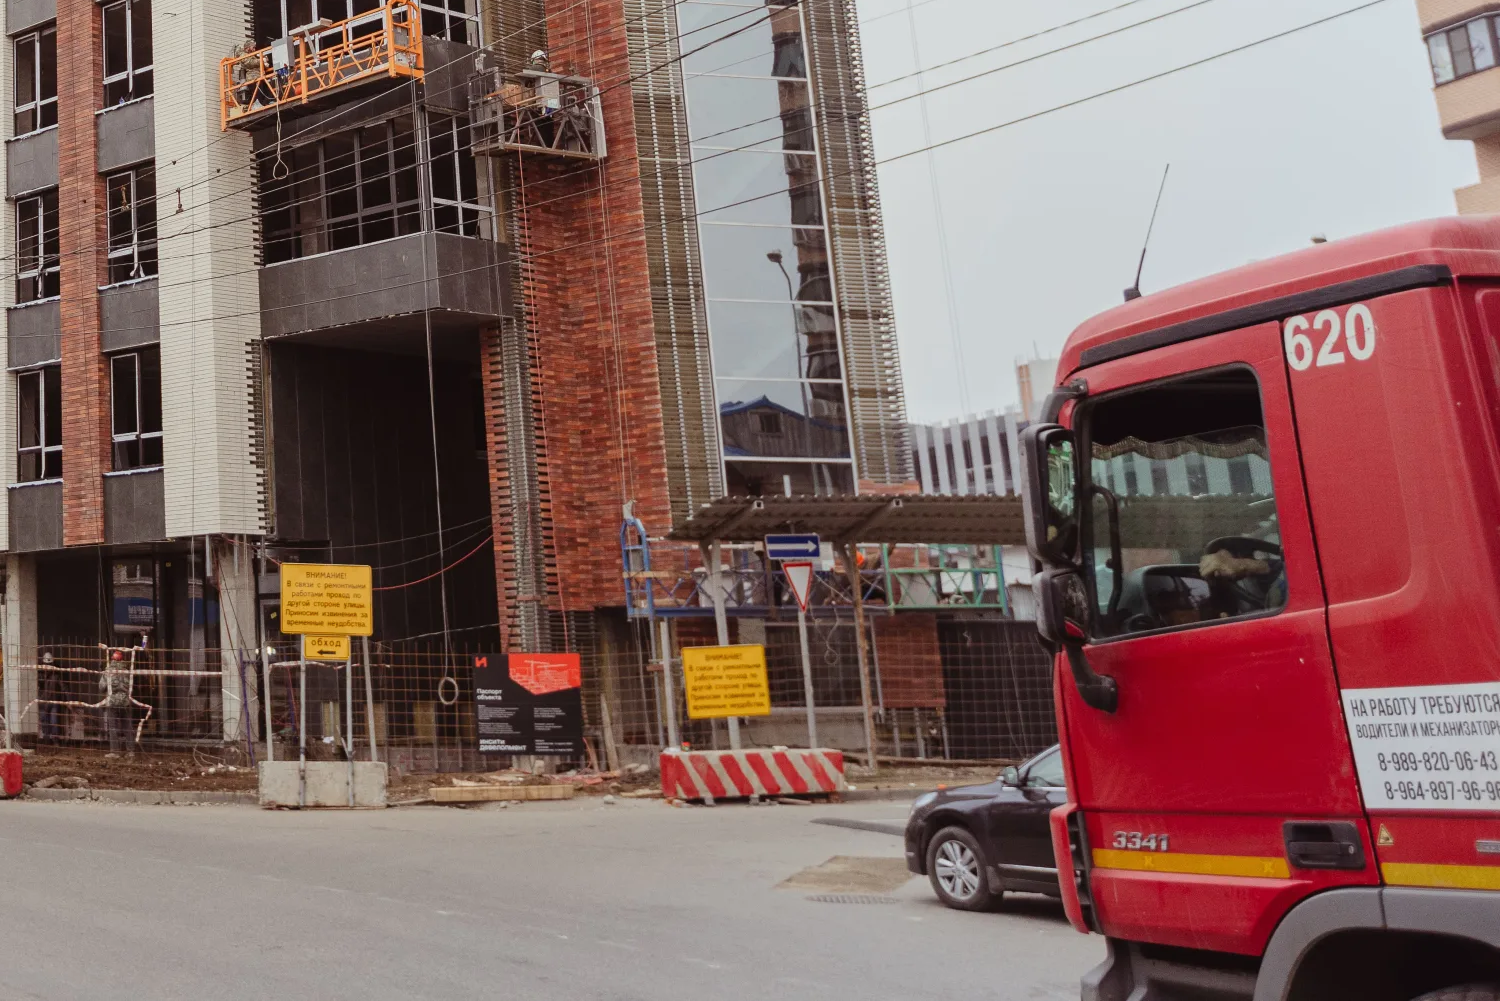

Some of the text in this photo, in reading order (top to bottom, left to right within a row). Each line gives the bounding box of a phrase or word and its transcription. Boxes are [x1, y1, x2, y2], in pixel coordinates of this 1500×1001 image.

[1284, 303, 1375, 371] 620
[305, 571, 347, 580] ВНИМАНИЕ!
[287, 600, 310, 608] другой
[313, 601, 340, 609] стороне
[285, 608, 318, 617] Приносим
[286, 619, 367, 629] временные неудобства.
[311, 638, 342, 647] обход
[1351, 693, 1500, 717] НА РАБОТУ ТРЕБУЮТСЯ
[1356, 722, 1410, 740] ВОДИТЕЛИ
[1411, 722, 1419, 737] И
[1377, 750, 1498, 772] 8-989-820-06-43
[1112, 830, 1170, 852] 3341
